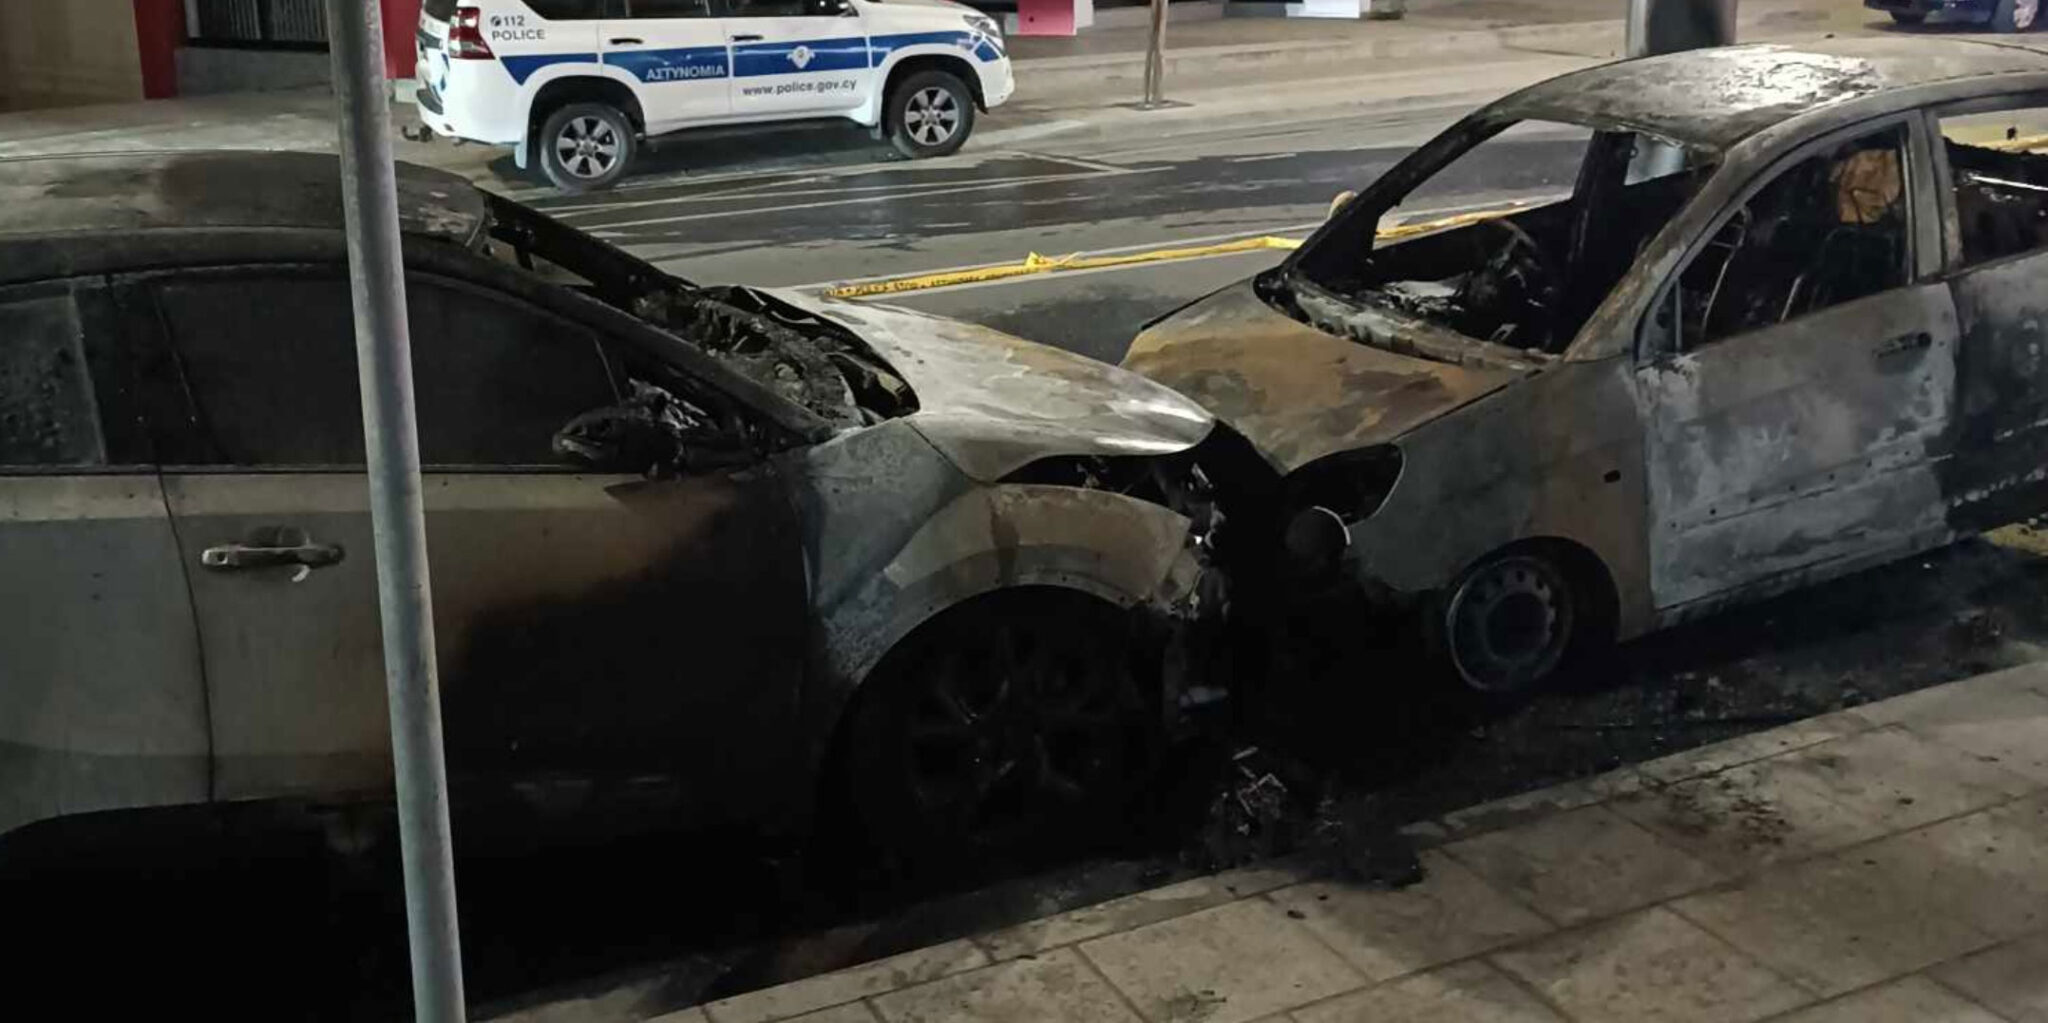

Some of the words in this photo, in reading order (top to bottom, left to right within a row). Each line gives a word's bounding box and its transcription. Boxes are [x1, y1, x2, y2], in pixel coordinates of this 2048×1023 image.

[504, 15, 525, 26] 112
[491, 29, 546, 41] POLICE
[647, 64, 725, 80] ΑΣΤΥΝΟΜΙΑ
[743, 80, 857, 95] www.police.gov.cy
